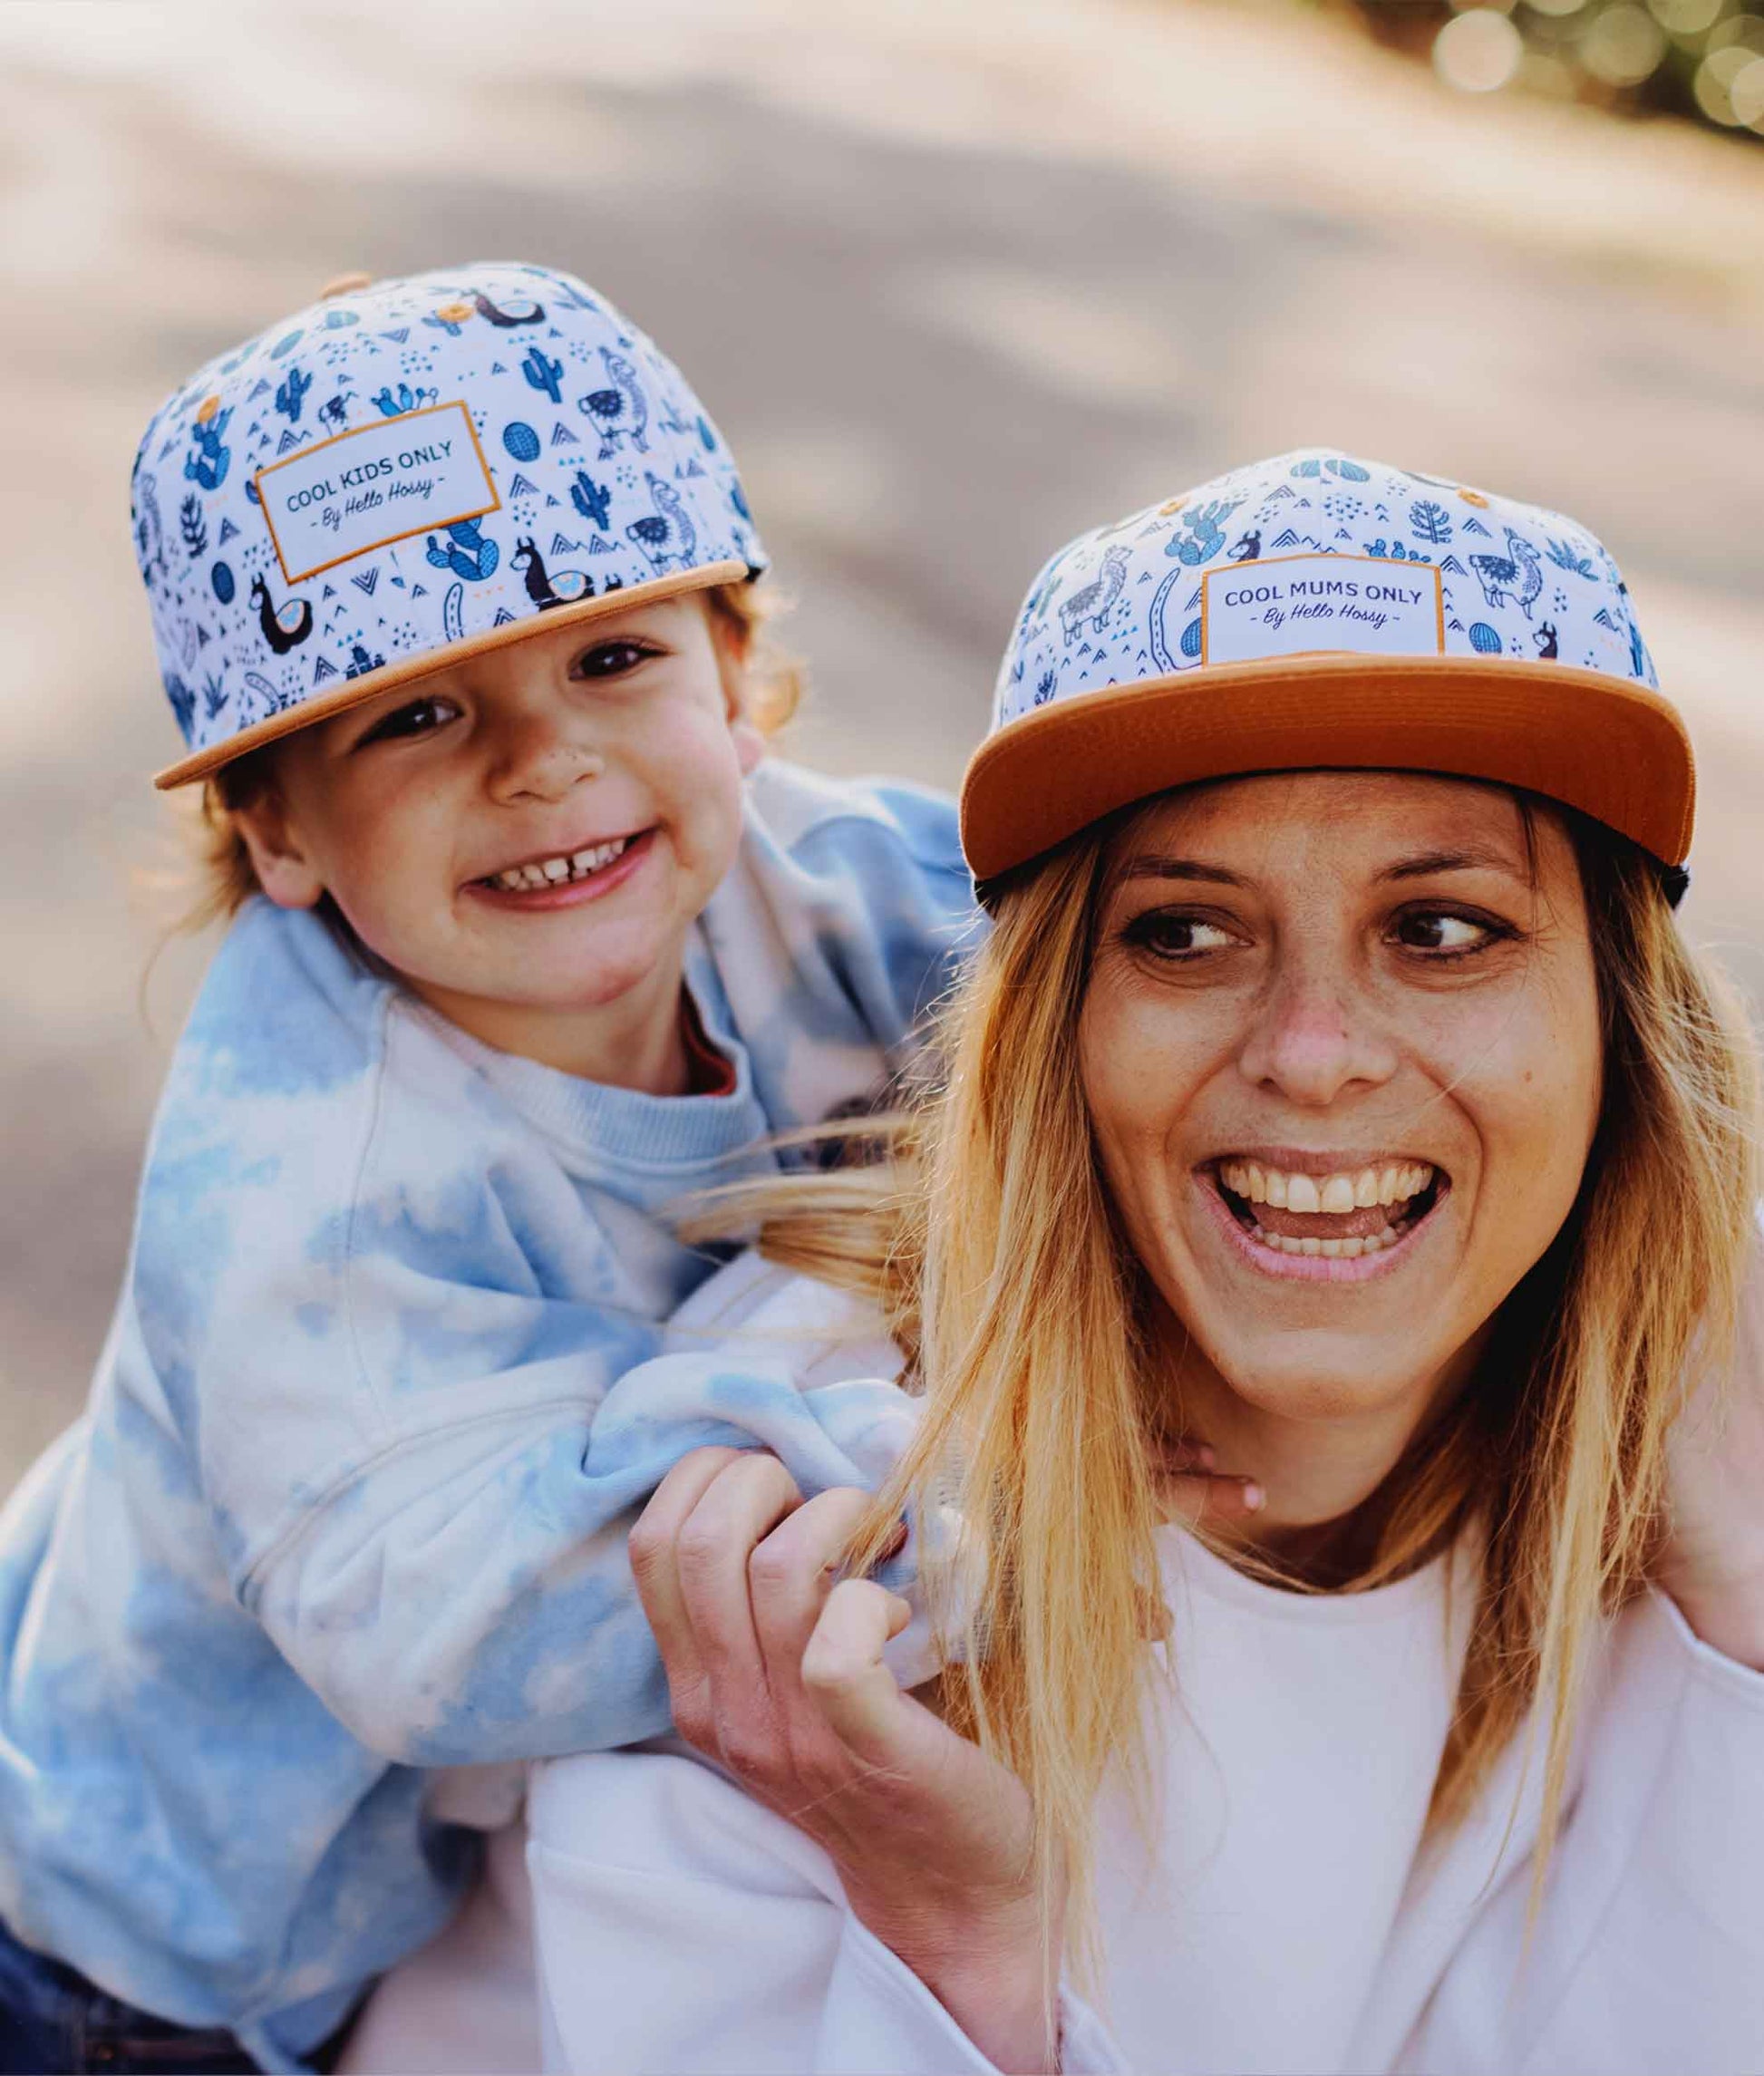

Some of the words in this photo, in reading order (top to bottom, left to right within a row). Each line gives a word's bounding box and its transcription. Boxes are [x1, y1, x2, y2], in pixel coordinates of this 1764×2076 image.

[287, 480, 337, 513] COOL
[340, 457, 393, 490] KIDS
[398, 440, 452, 469] ONLY
[322, 507, 342, 532] By
[344, 490, 384, 516] Hello
[389, 478, 435, 500] Hossy
[1225, 586, 1283, 607] COOL
[1290, 580, 1359, 597] MUMS
[1365, 585, 1422, 606] ONLY
[1263, 606, 1286, 630] By
[1290, 602, 1333, 620] Hello
[1339, 604, 1389, 630] Hossy
